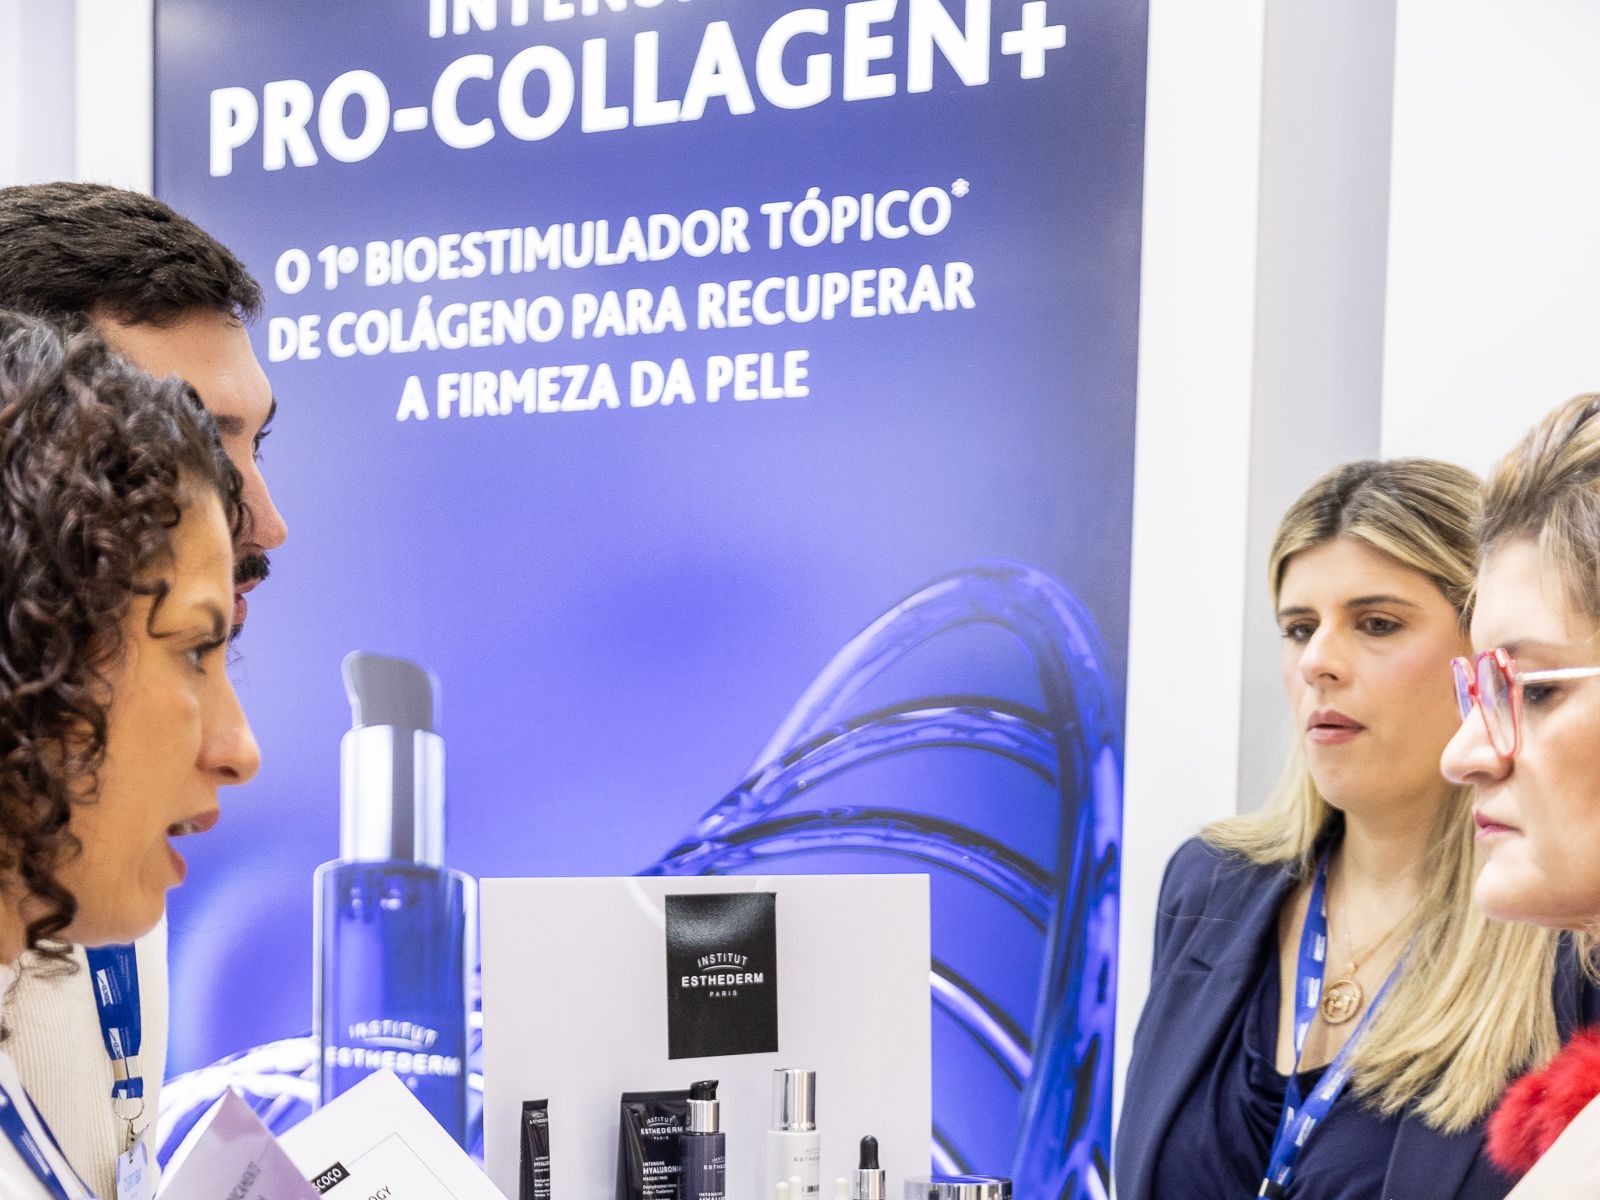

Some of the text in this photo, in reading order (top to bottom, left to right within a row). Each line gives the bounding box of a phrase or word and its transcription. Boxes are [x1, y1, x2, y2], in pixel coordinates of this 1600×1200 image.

[209, 0, 1067, 178] PRO-COLLAGEN+
[274, 248, 311, 294] O
[365, 206, 751, 288] BIOESTIMULADOR
[268, 261, 977, 362] DE COLÁGENO PARA RECUPERAR
[395, 349, 810, 421] A FIRMEZA DA PELE
[697, 952, 748, 968] INSTITUT
[681, 972, 764, 987] ESTHEDERM
[709, 989, 738, 997] PARIS
[646, 1116, 673, 1125] INSTITUT
[641, 1126, 683, 1135] ESTHEDERM
